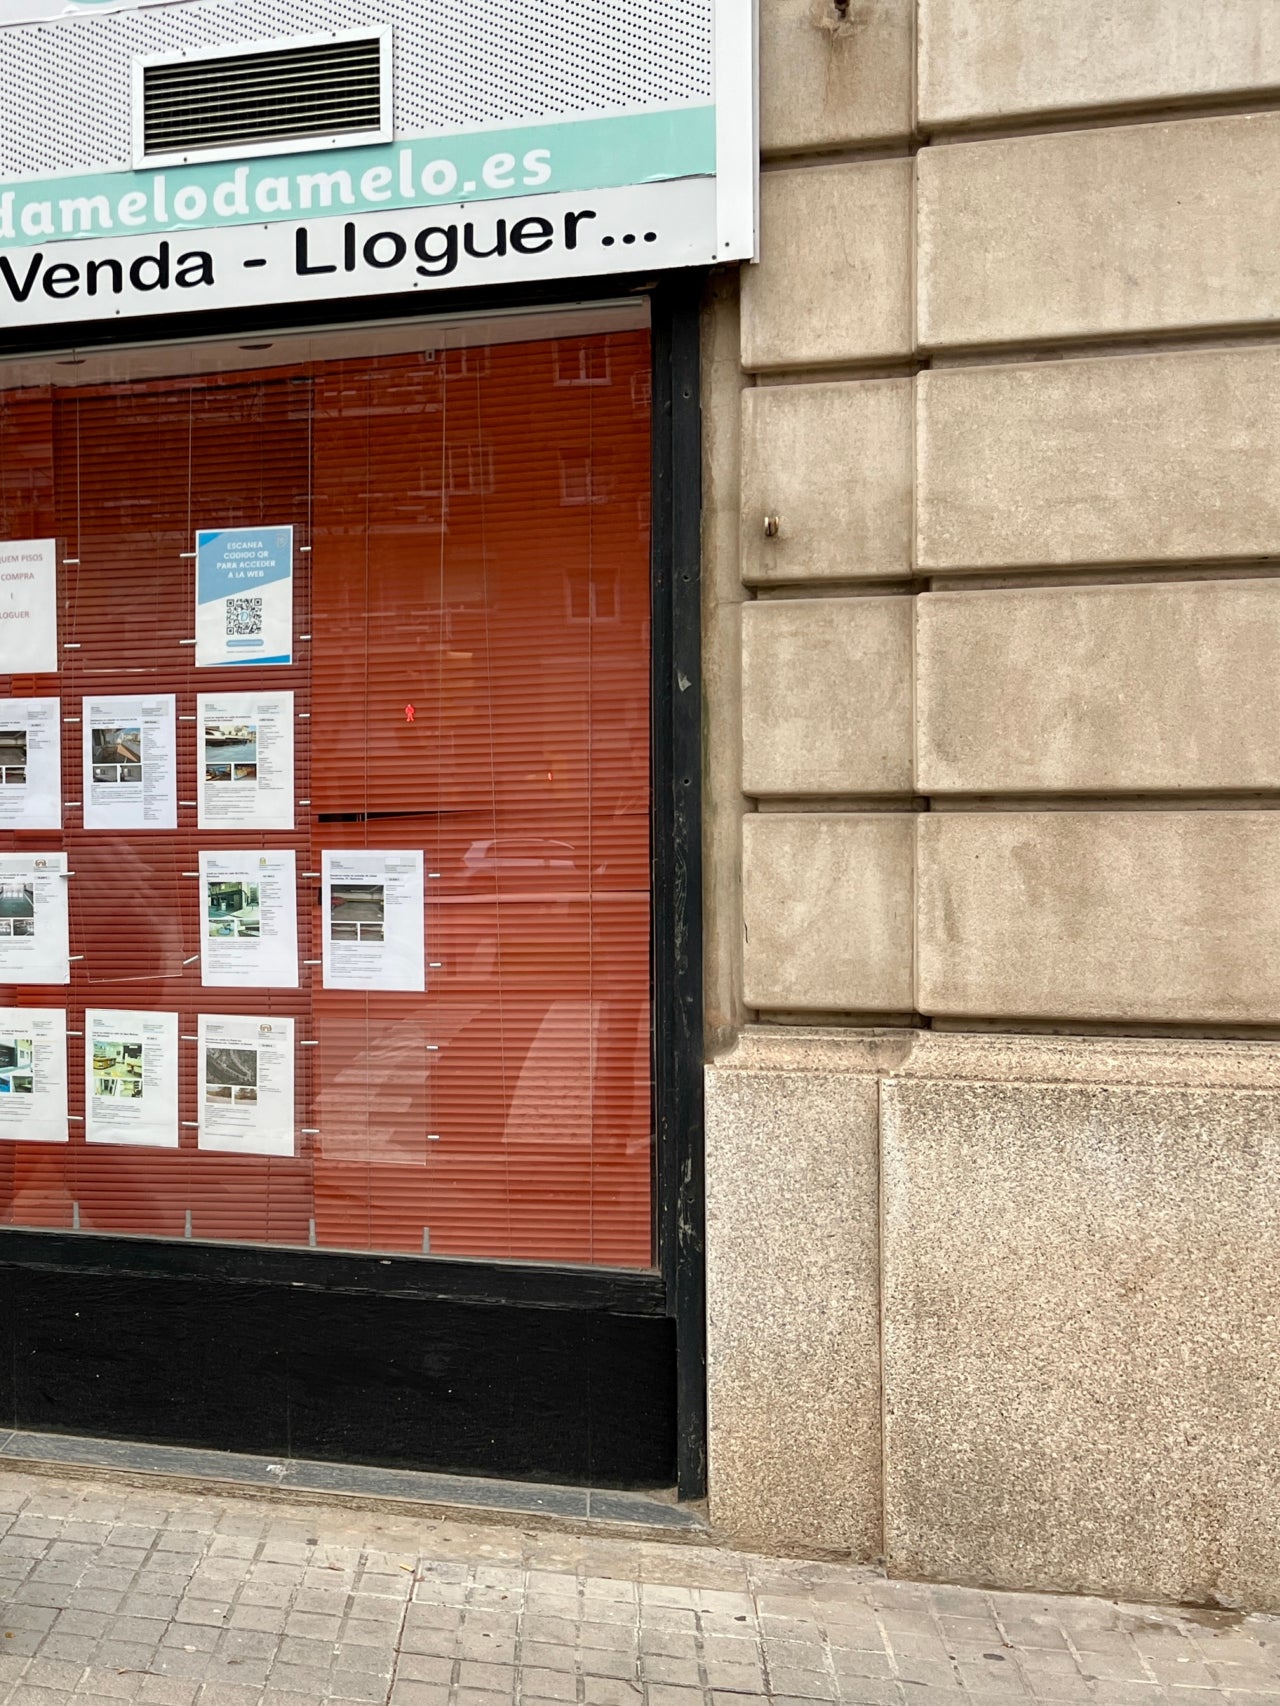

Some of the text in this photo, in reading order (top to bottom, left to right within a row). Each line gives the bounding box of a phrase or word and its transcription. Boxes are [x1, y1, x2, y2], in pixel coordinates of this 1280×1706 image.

[295, 209, 657, 277] Lloguer...
[227, 541, 263, 550] ESCANEA
[21, 553, 44, 563] PISOS
[257, 550, 269, 559] QR
[216, 559, 276, 570] PARA ACCEDER
[1, 572, 35, 581] COMPRA
[235, 571, 246, 579] LA
[246, 570, 265, 578] WEB
